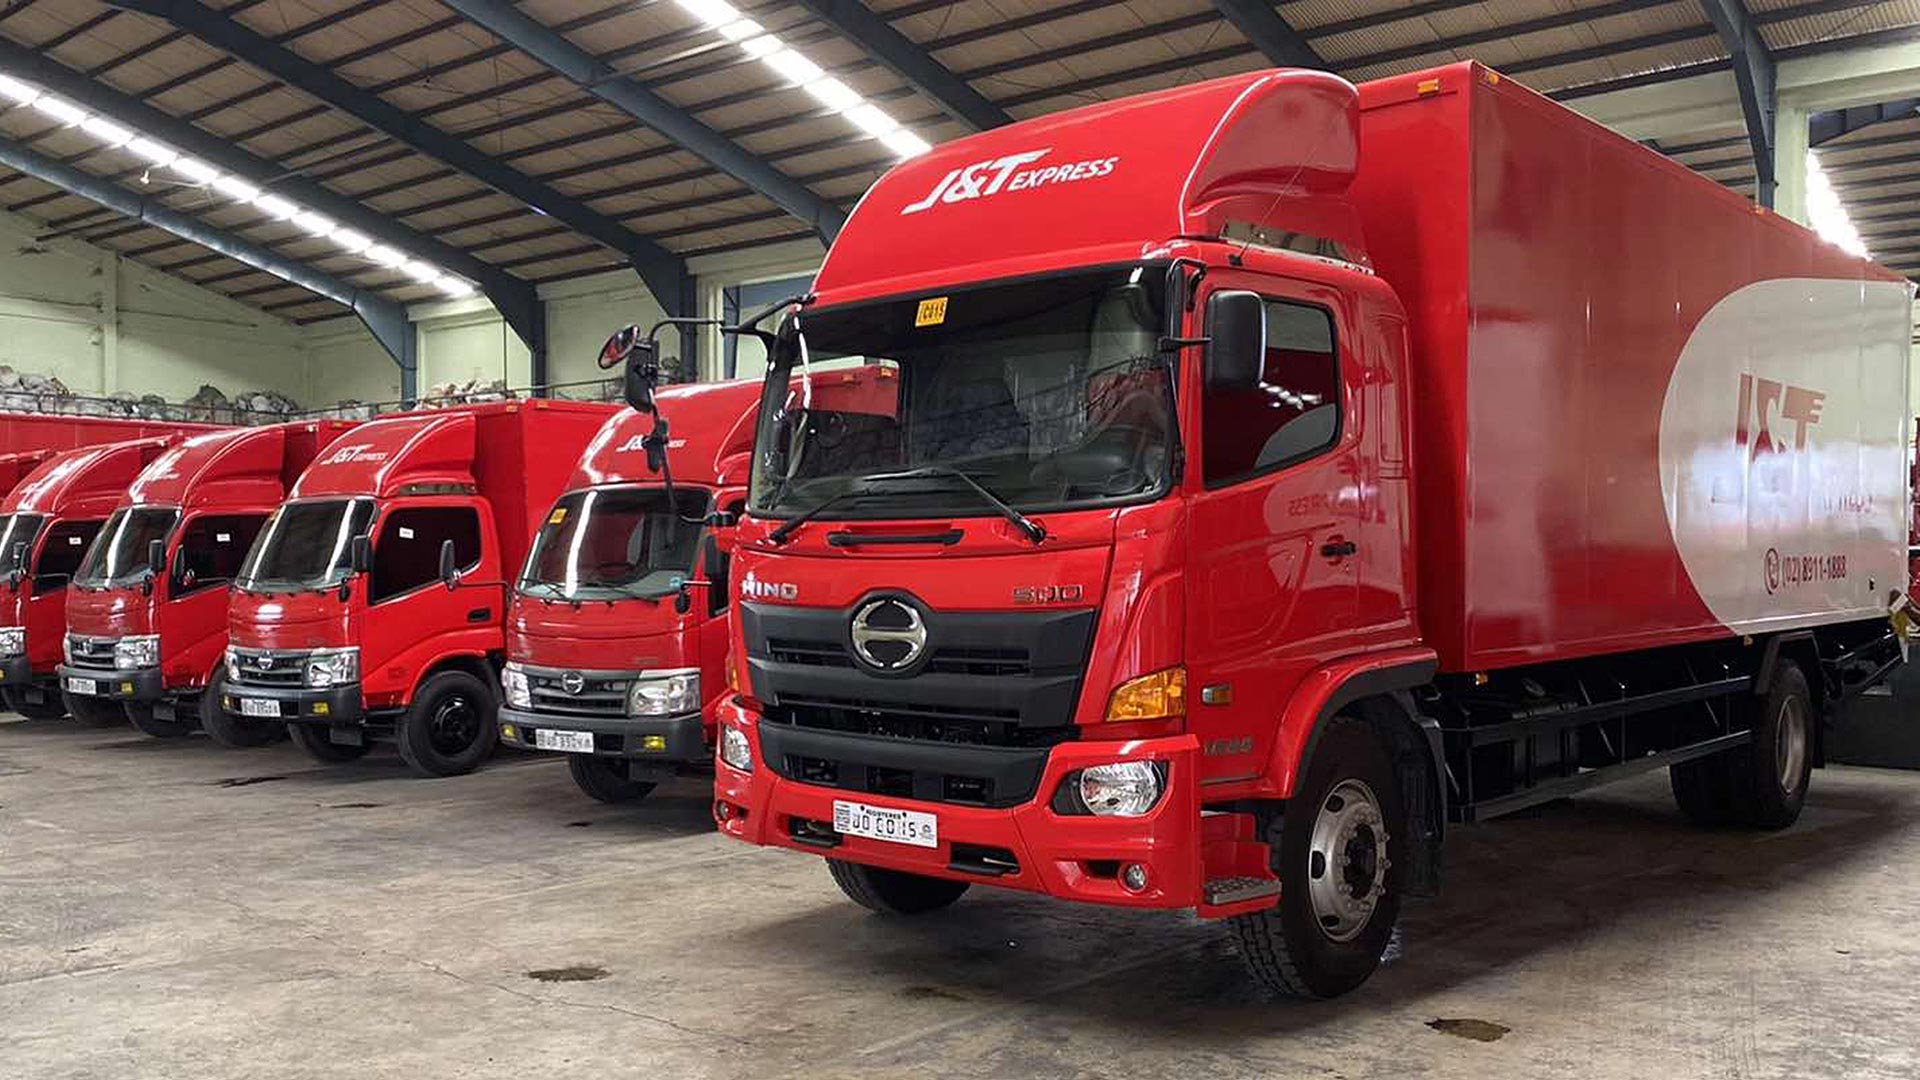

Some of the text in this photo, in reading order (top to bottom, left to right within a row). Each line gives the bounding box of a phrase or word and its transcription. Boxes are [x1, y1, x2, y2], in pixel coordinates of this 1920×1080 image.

[901, 148, 1120, 216] J&T EXPRESS
[1781, 555, 1847, 588] (02) 8911-1888
[742, 579, 798, 600] HINO
